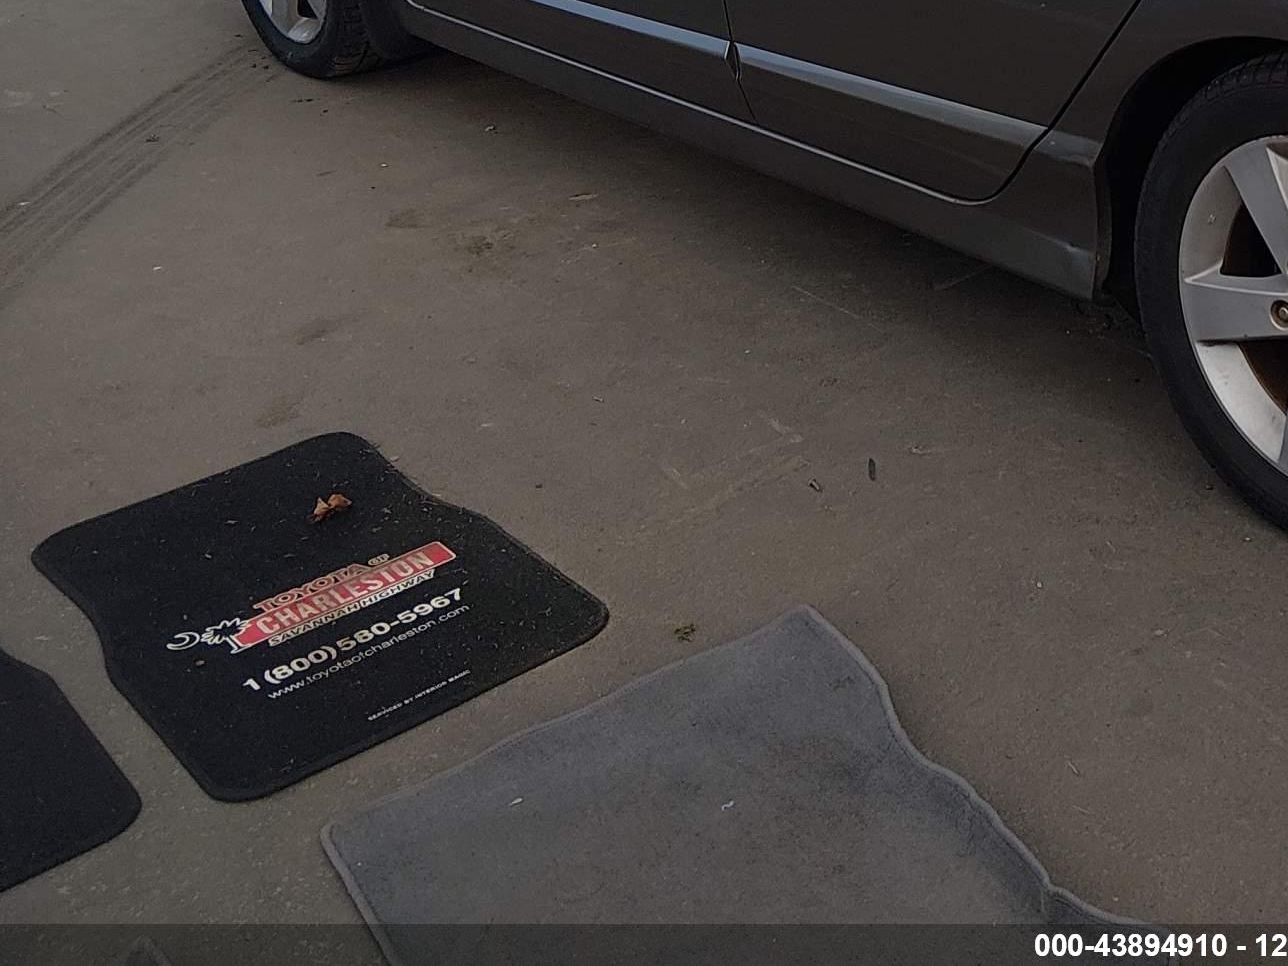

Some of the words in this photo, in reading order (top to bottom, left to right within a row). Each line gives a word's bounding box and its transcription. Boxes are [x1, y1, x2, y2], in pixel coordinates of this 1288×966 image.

[252, 563, 372, 611] TOYOTA
[256, 551, 434, 635] CHARLESTON
[268, 602, 361, 647] SAVANNAH
[360, 569, 435, 608] HIGHWAY
[242, 678, 261, 691] 1
